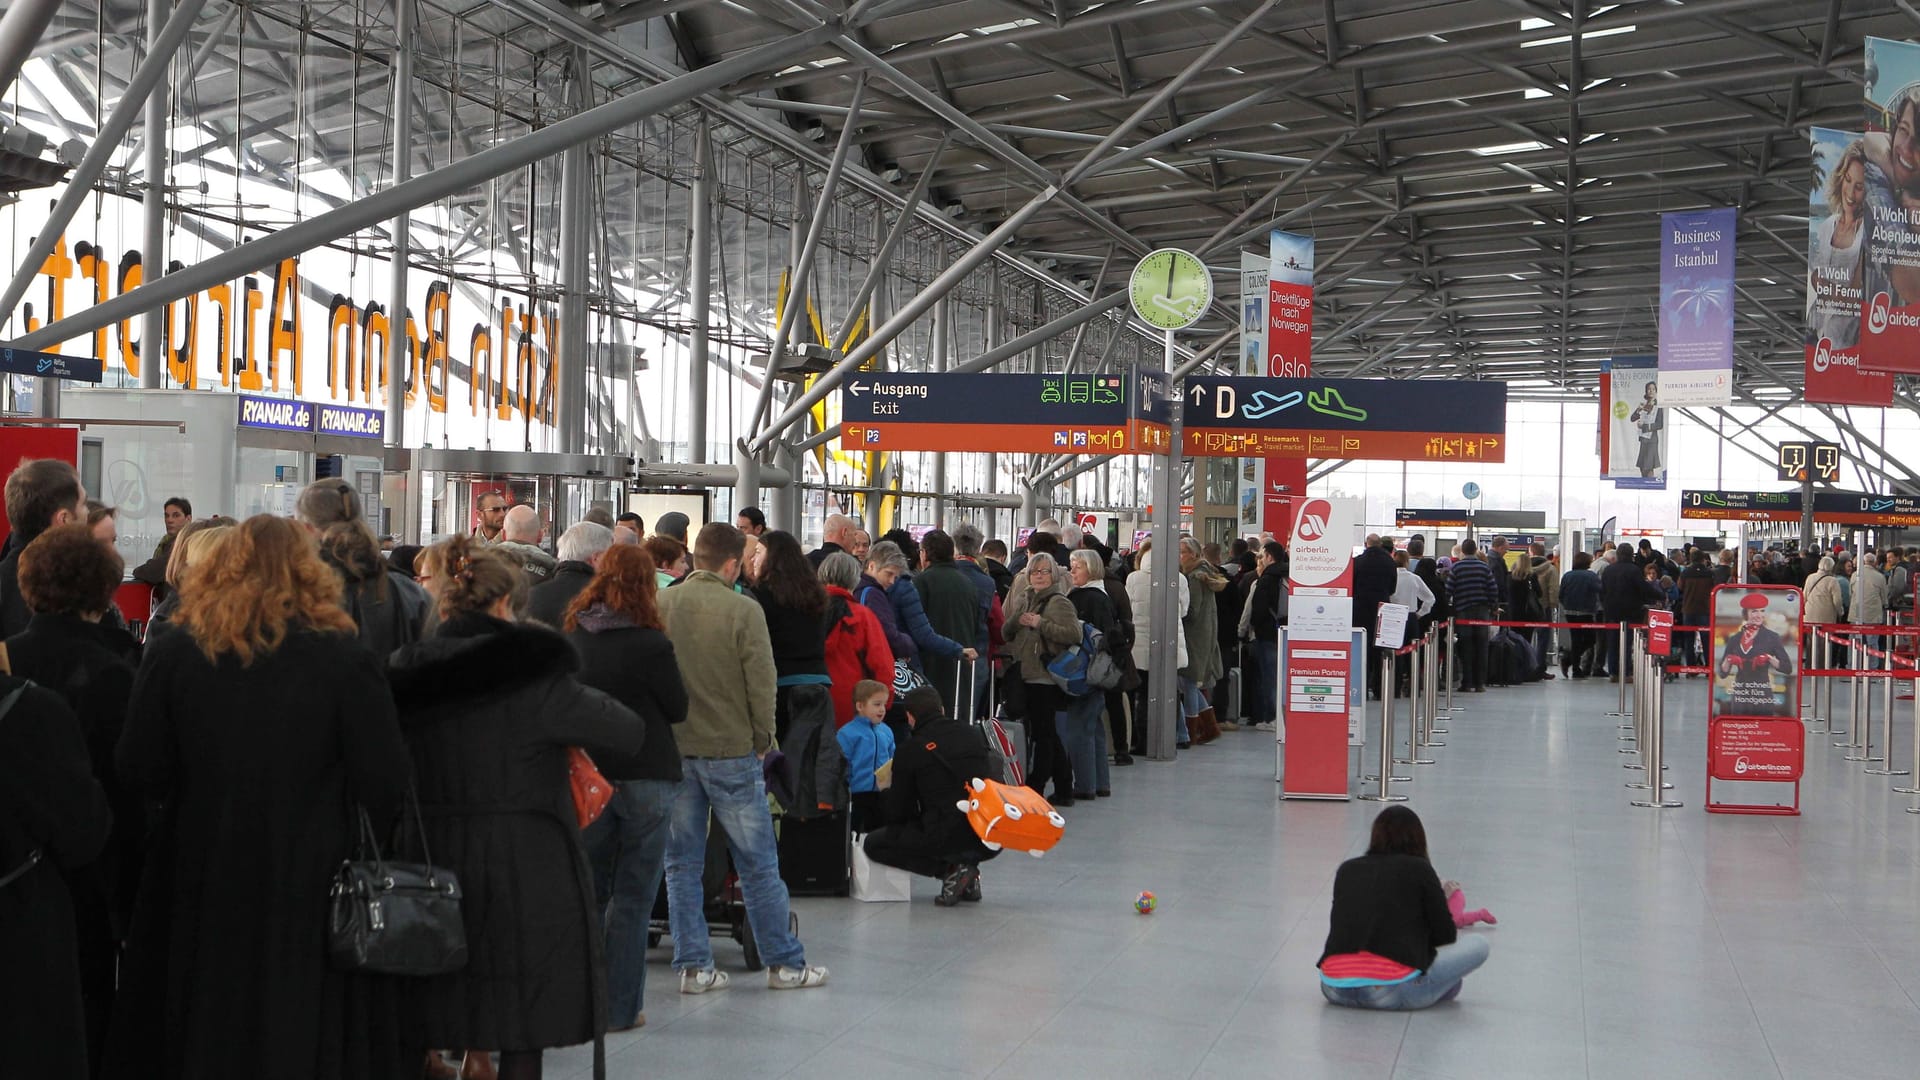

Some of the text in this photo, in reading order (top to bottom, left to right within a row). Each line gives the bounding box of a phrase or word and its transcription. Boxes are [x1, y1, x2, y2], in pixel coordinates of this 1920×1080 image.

[1880, 206, 1908, 224] Wahl
[1674, 229, 1721, 245] Business
[1675, 249, 1718, 268] Istanbul
[1825, 267, 1850, 281] Wahl
[1816, 281, 1833, 296] bei
[1271, 290, 1311, 310] Direktflüge
[1281, 307, 1300, 319] nach
[1271, 316, 1309, 334] Norwegen
[1271, 353, 1307, 377] Oslo
[873, 382, 928, 399] Ausgang
[1042, 379, 1060, 388] Taxi
[873, 401, 900, 415] Exit
[1216, 386, 1236, 419] D
[242, 400, 310, 428] RYANAIR.de
[321, 409, 381, 434] RYANAIR.de
[867, 430, 880, 442] P2
[1073, 432, 1087, 445] P3
[1264, 435, 1300, 443] Reisemarkt
[1693, 492, 1701, 506] D
[1727, 493, 1748, 501] Ankunft
[1895, 498, 1914, 507] Abflug
[1860, 498, 1869, 511] D
[1290, 668, 1347, 677] Premium Partner
[1751, 689, 1765, 697] fürs
[1748, 763, 1792, 771] airberlin.com
